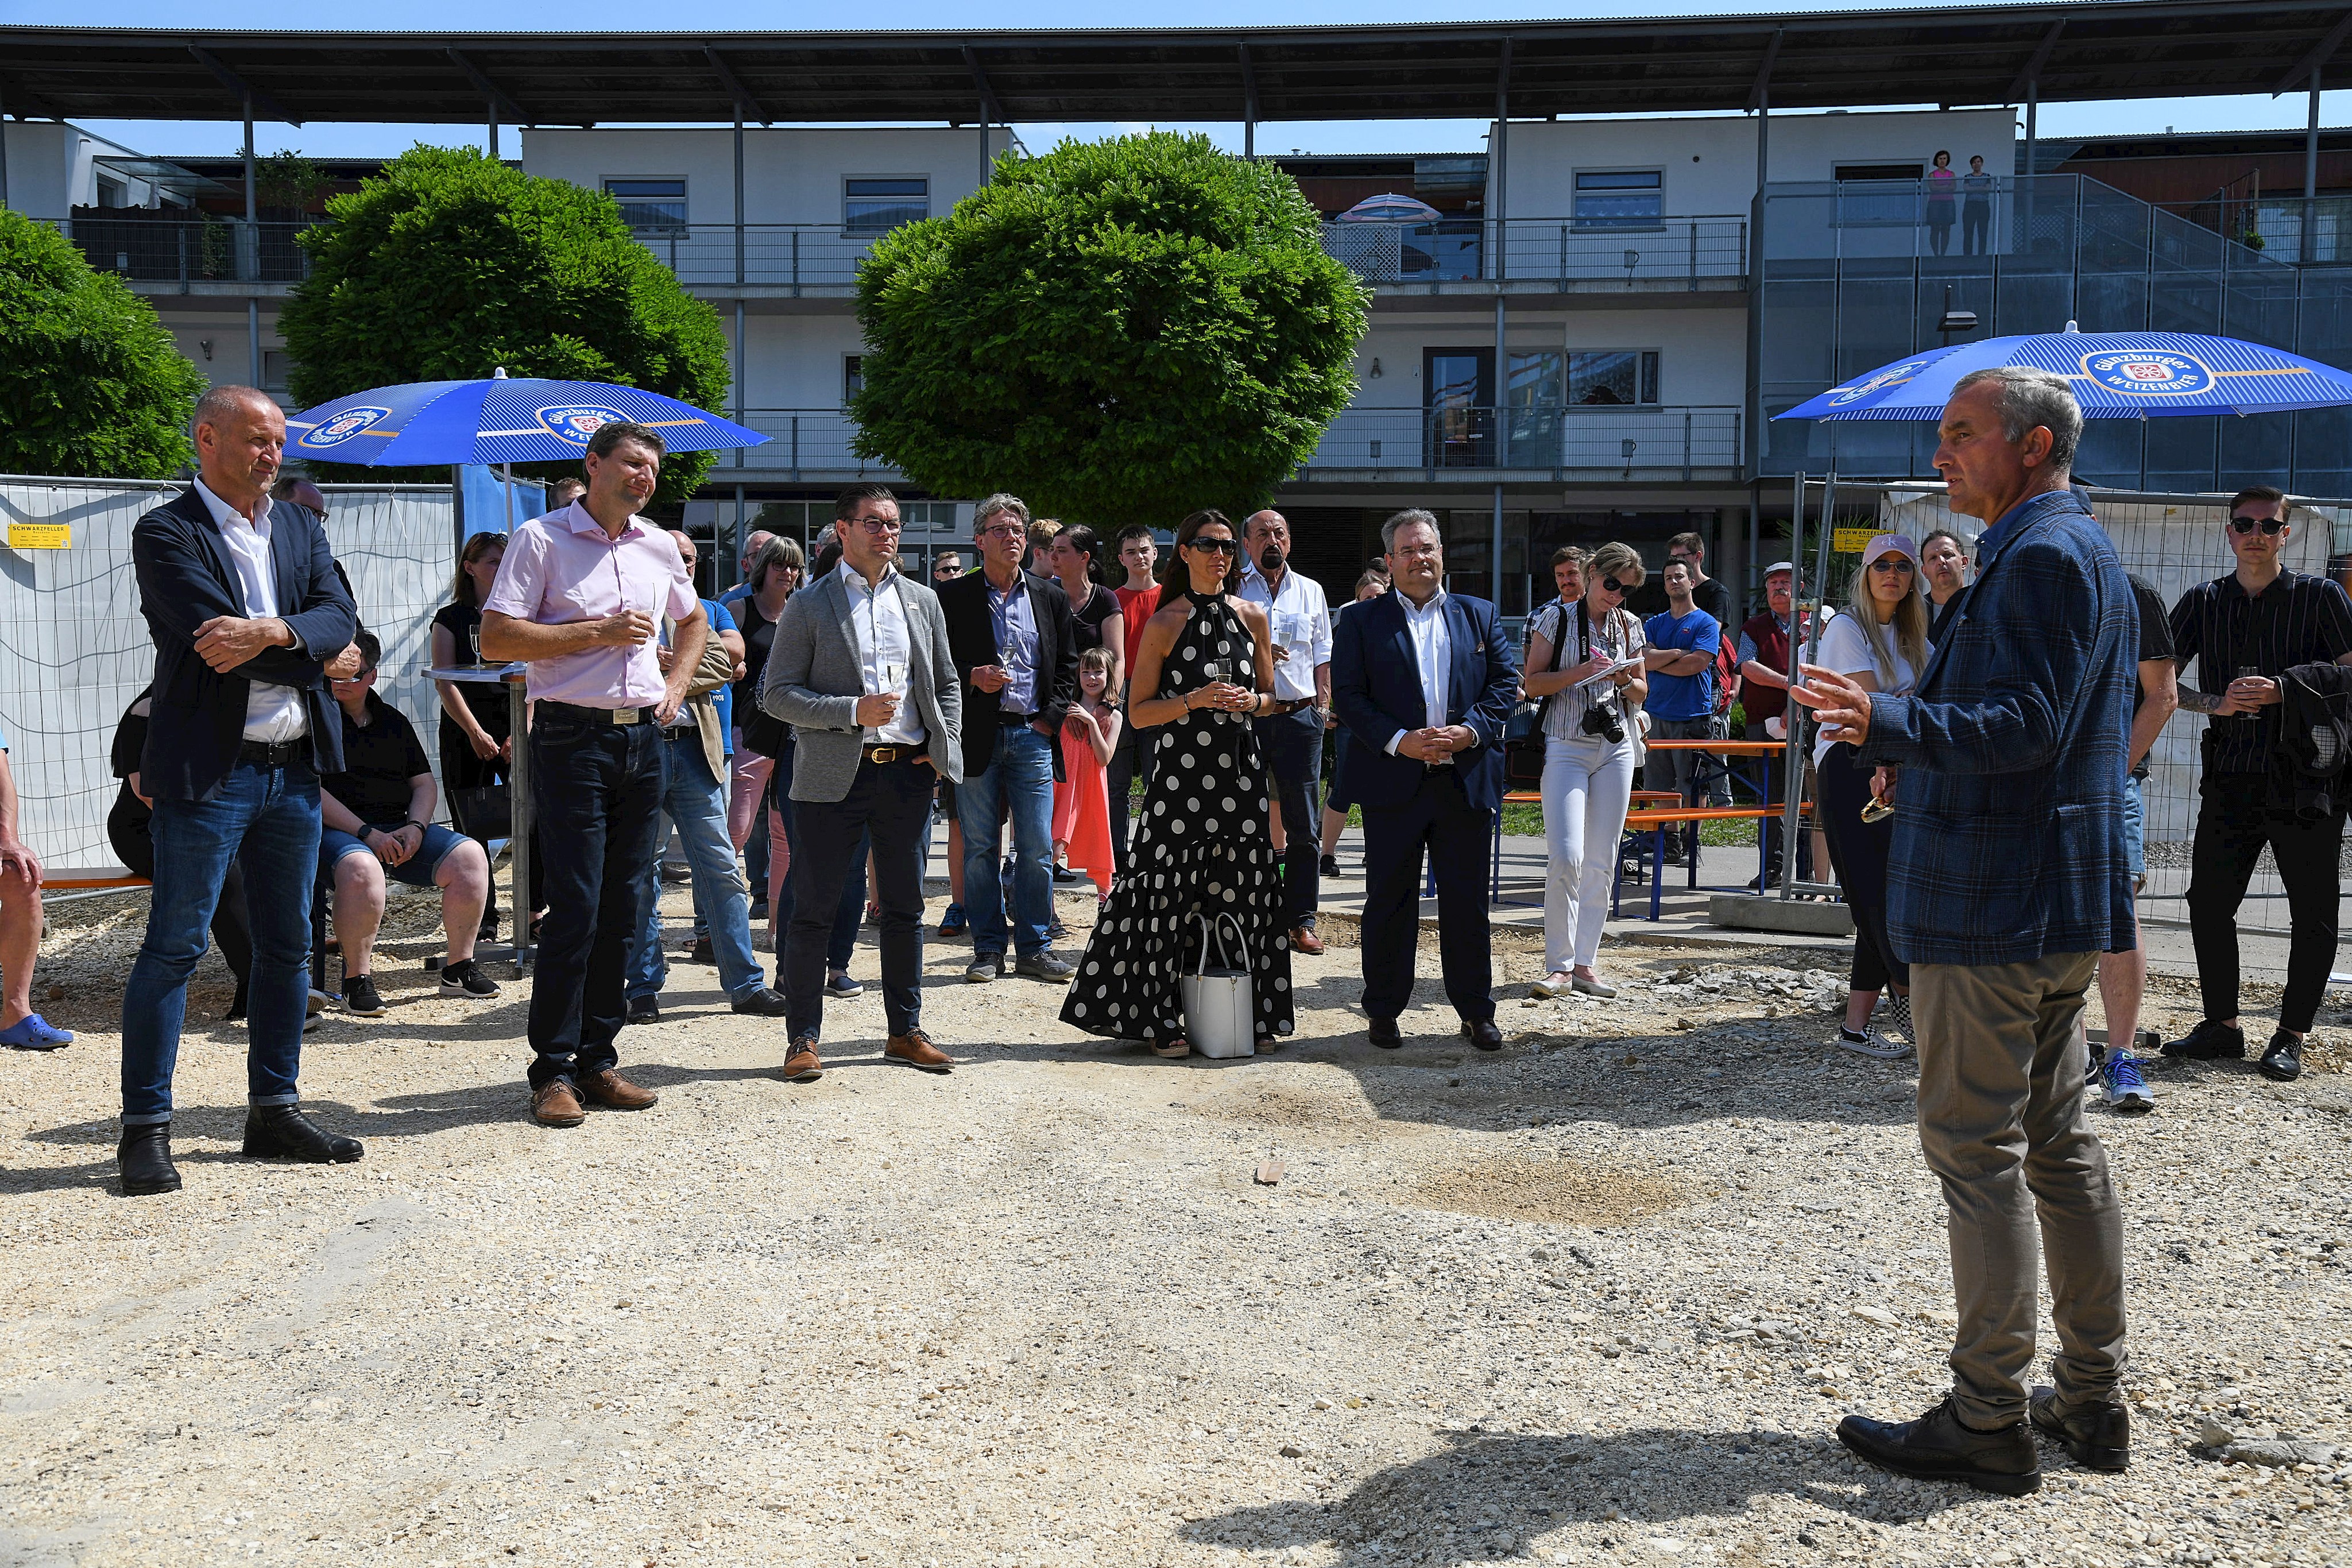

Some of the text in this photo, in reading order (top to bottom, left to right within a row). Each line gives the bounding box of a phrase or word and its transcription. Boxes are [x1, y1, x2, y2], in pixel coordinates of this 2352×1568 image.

[2094, 353, 2192, 371] Günzburger
[2106, 374, 2199, 391] WEIZENBIER
[548, 408, 621, 425] Günzburger
